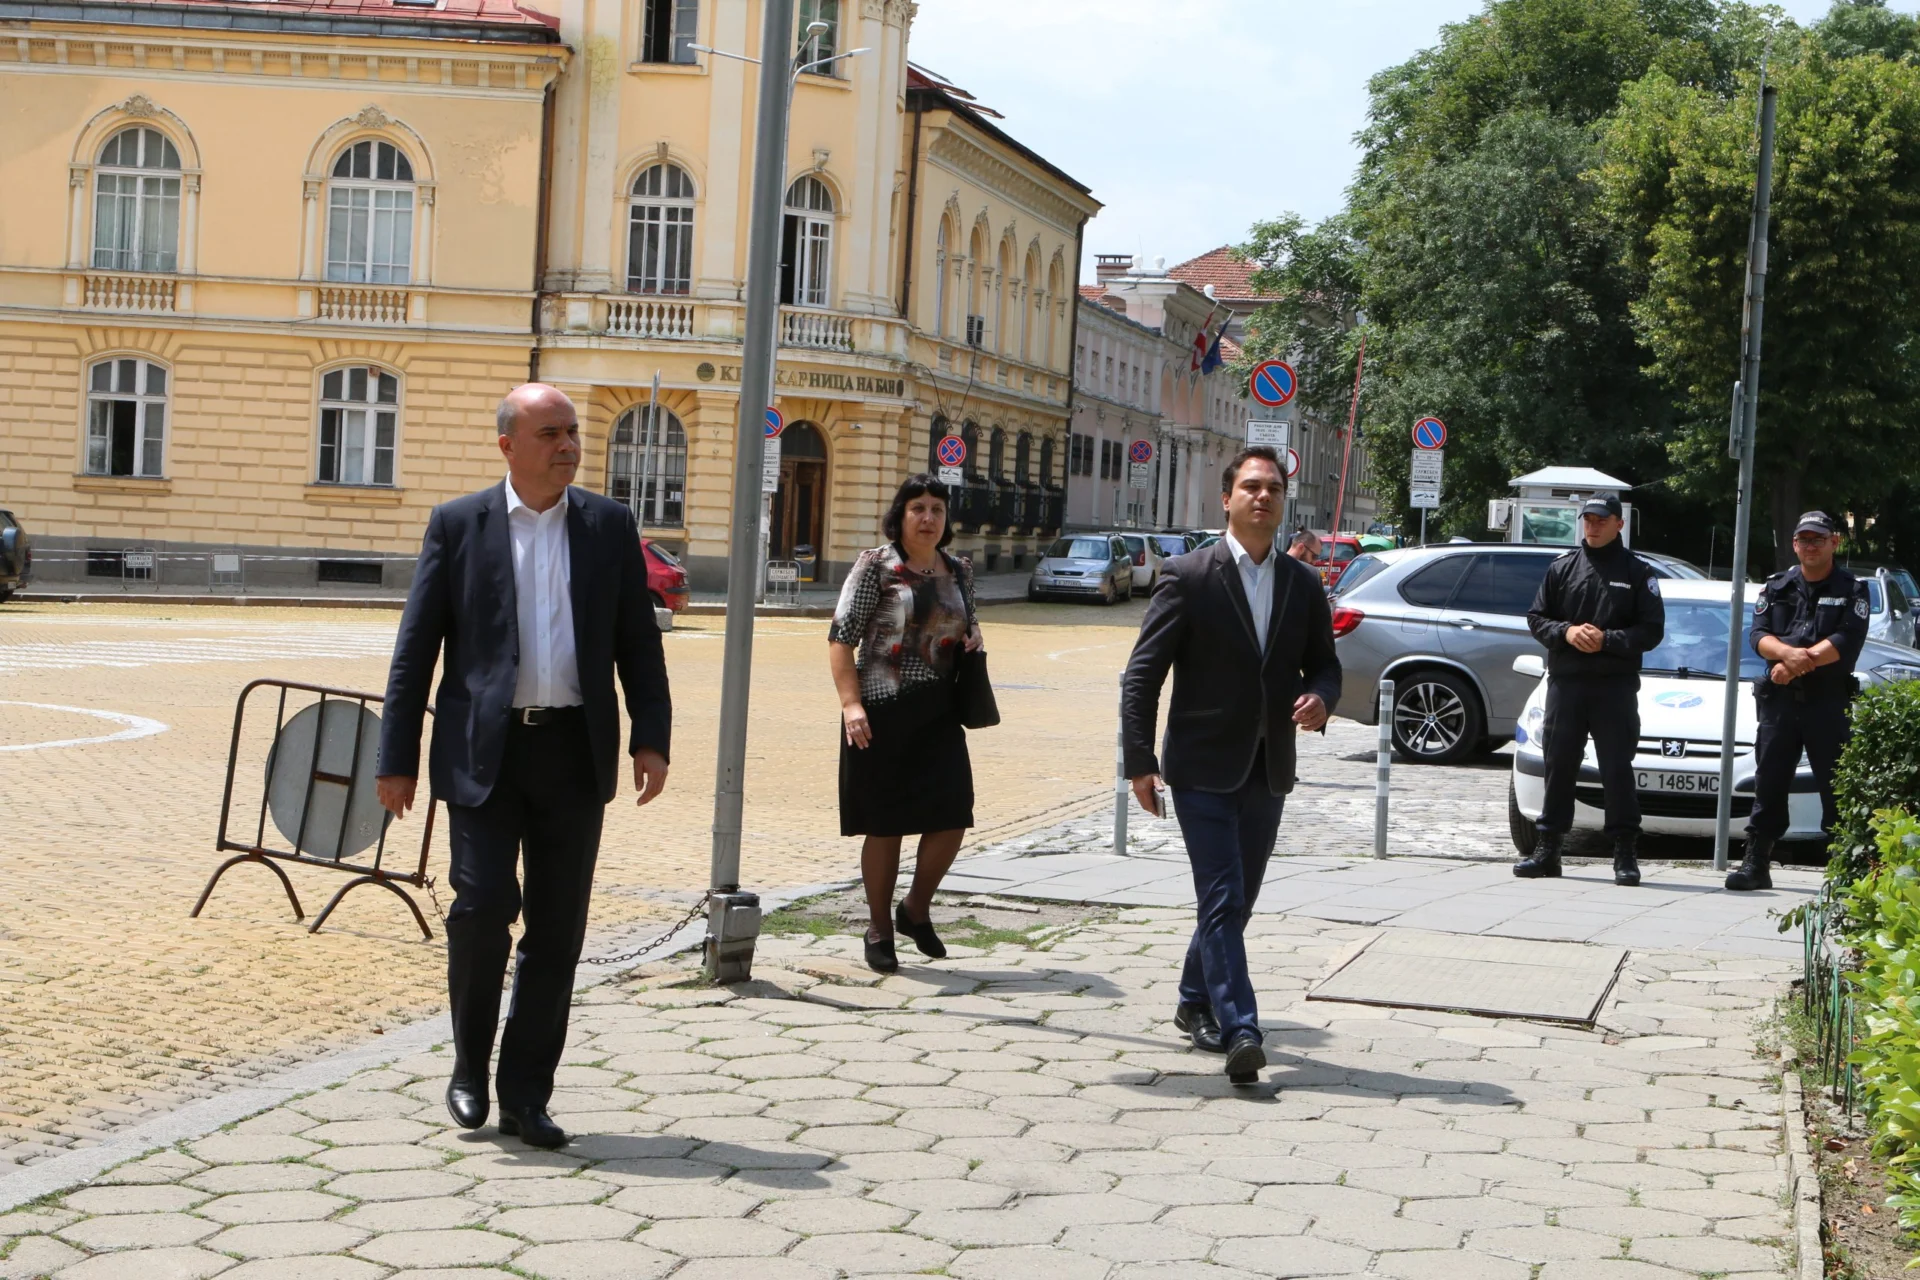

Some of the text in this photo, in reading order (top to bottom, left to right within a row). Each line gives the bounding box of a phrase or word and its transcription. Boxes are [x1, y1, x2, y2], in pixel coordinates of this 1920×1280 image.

[856, 376, 874, 392] НА
[875, 378, 895, 394] БАН
[1637, 772, 1720, 792] C 1485 MC
